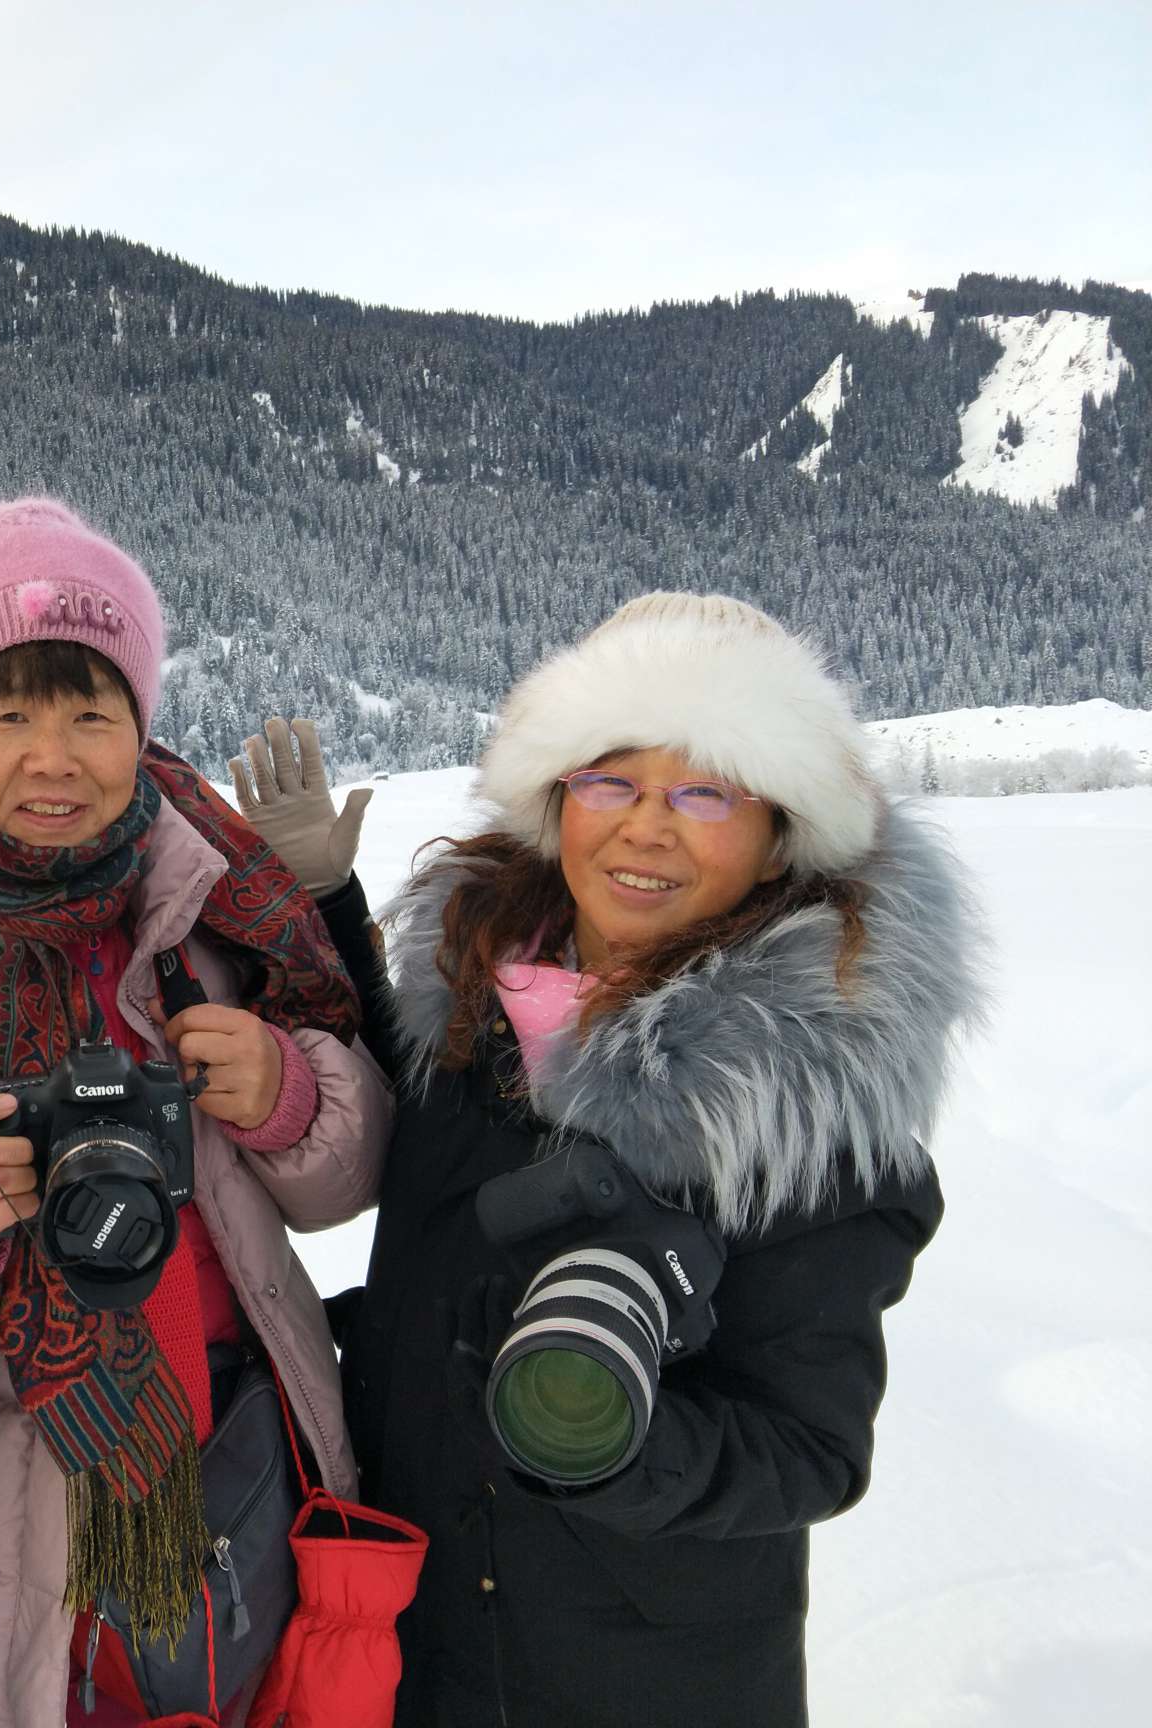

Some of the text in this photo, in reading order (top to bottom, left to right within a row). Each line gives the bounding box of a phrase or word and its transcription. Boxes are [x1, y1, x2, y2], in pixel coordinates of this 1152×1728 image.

[74, 1084, 125, 1097] Canon
[161, 1102, 179, 1114] EOS
[165, 1112, 177, 1122] 7D
[92, 1202, 126, 1250] TAMRON
[665, 1249, 695, 1296] Canon
